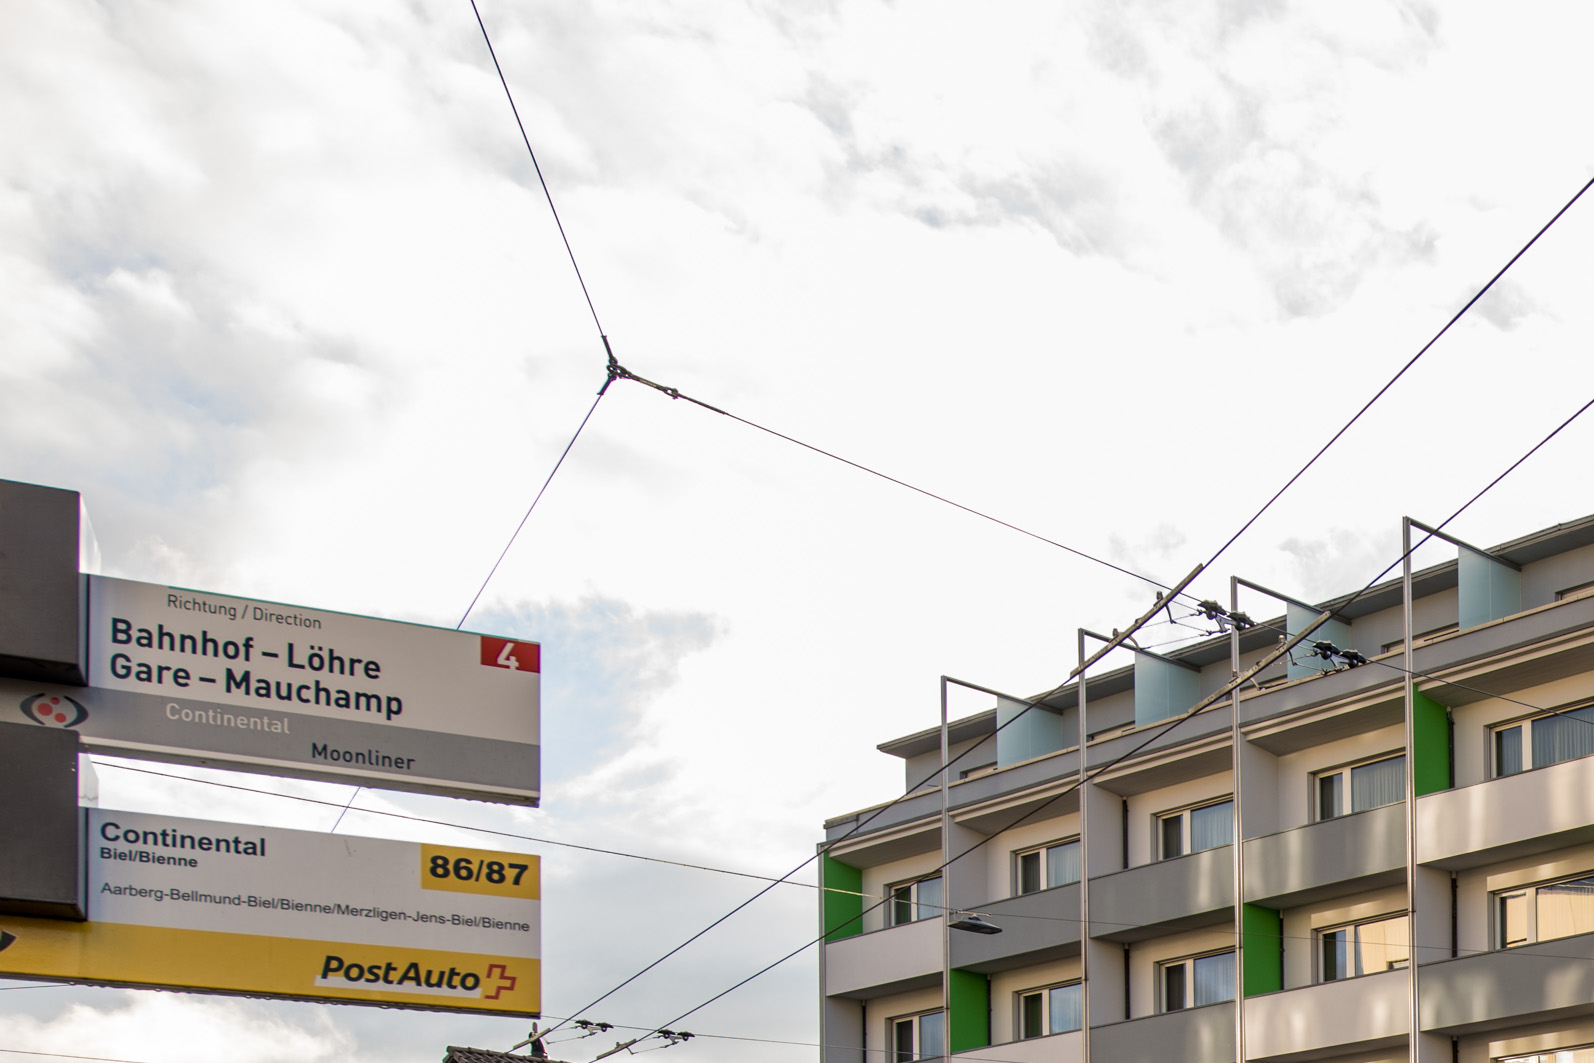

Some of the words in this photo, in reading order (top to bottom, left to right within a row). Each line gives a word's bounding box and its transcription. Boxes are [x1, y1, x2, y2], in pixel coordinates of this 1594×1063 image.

[167, 593, 237, 621] Richtung
[253, 606, 322, 630] Direction
[111, 617, 254, 662] Bahnhof
[287, 642, 382, 680] Löhre
[496, 642, 519, 671] 4
[110, 653, 191, 688] Gare
[225, 667, 404, 721] Mauchamp
[165, 702, 291, 734] Continental
[311, 742, 415, 771] Moonliner
[100, 821, 267, 857] Continental
[100, 846, 199, 868] Biel/Bienne
[429, 855, 529, 886] 86/87
[100, 882, 530, 932] Aarberg-Bellmund-Biel/Bienne/Merzligen-Jens-Biel/Bienne
[320, 955, 481, 992] PostAuto
